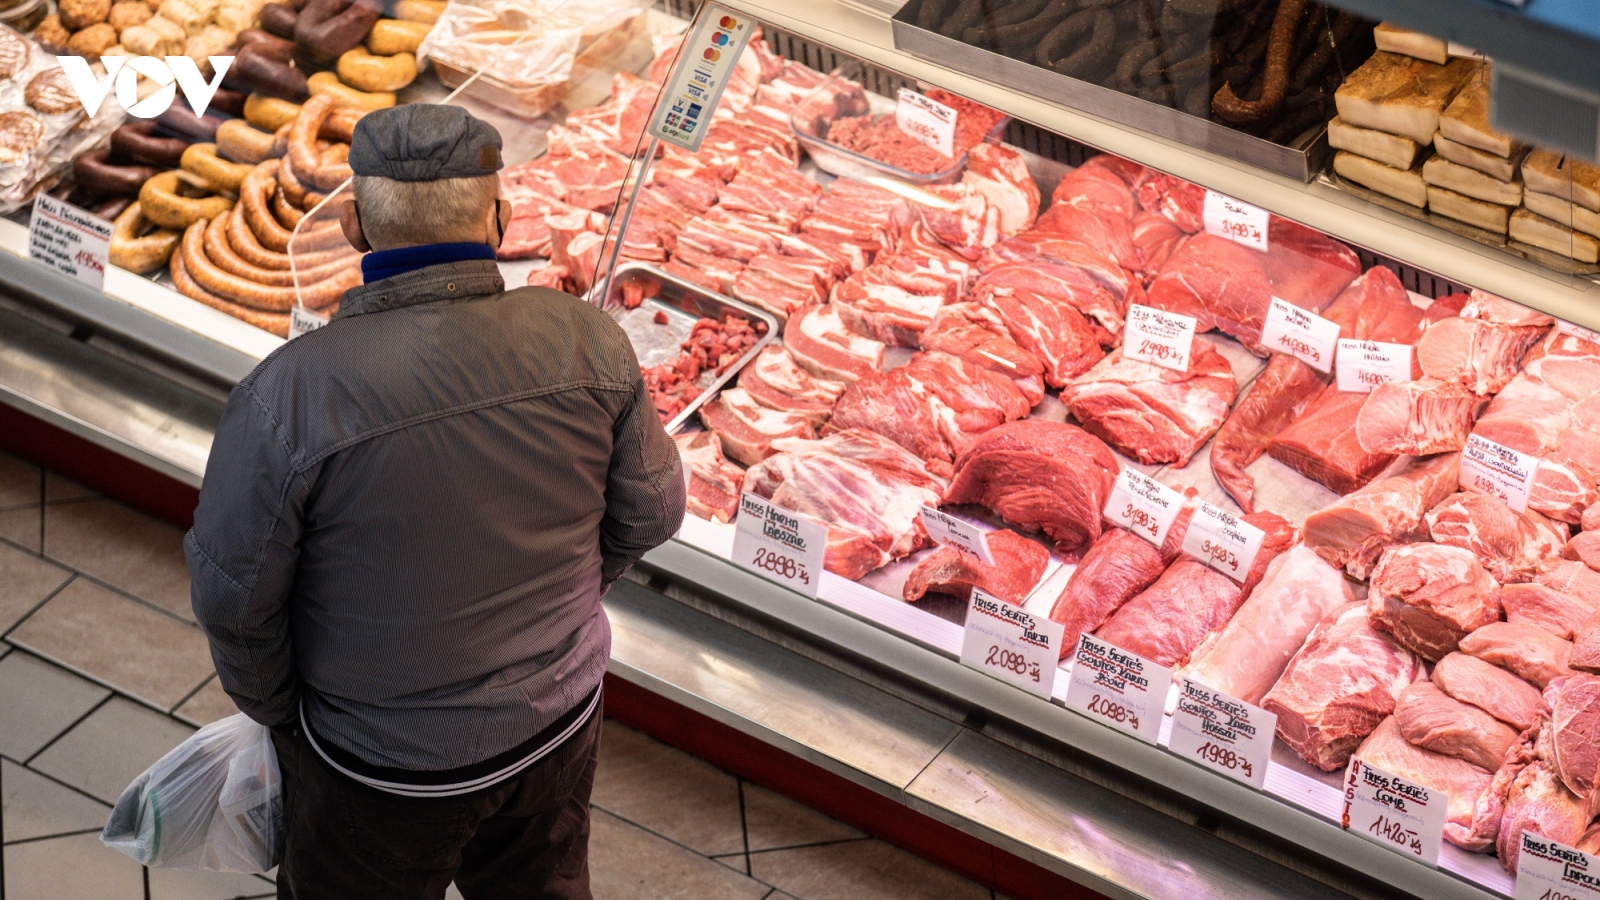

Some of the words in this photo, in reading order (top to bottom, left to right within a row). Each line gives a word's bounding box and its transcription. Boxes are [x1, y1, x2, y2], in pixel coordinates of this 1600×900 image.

[694, 73, 708, 84] VISA
[688, 87, 701, 98] VISA
[741, 493, 764, 515] FRISS
[765, 505, 799, 531] MARHA
[973, 591, 998, 613] FRISS
[1081, 634, 1106, 655] FRISS
[1077, 650, 1117, 674] CSONTOS
[1183, 679, 1210, 702] FRISS
[1179, 697, 1217, 719] CSONTOS
[1363, 764, 1390, 788] FRISS
[1375, 789, 1405, 809] COMB
[1522, 832, 1548, 854] FRISS
